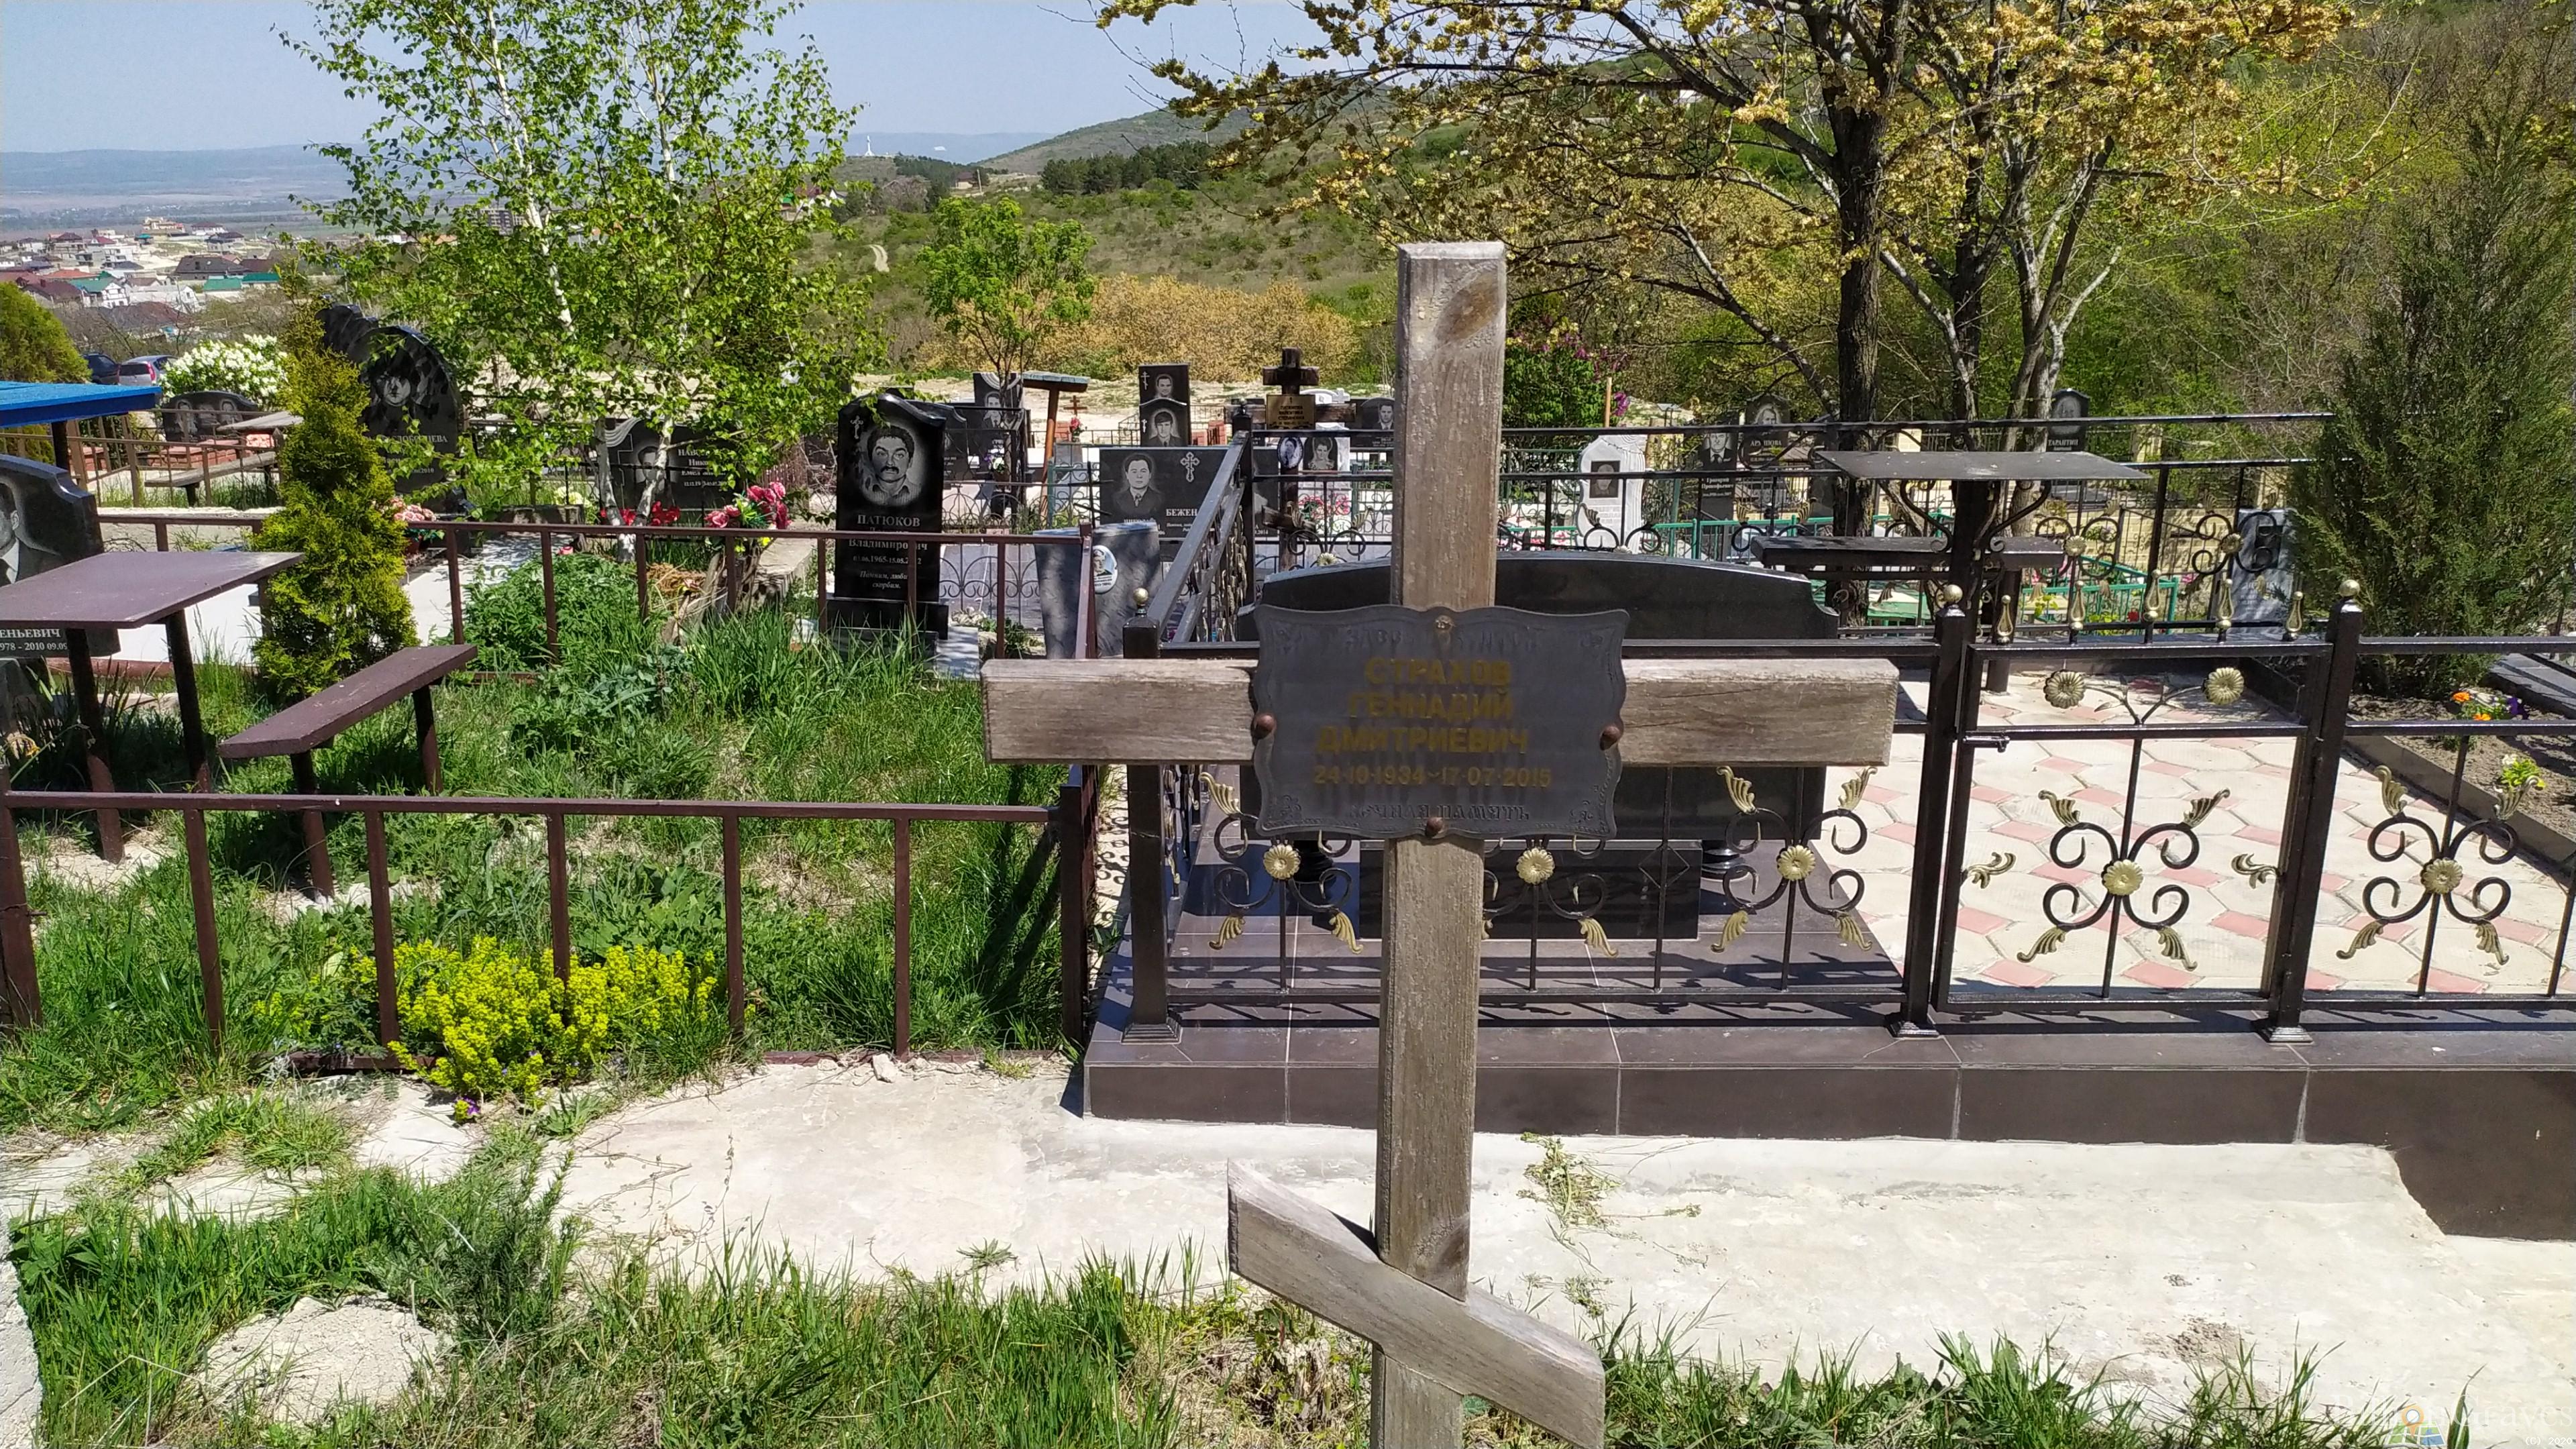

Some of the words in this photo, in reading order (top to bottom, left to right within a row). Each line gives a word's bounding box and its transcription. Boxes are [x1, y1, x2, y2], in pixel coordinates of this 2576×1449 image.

[1165, 508, 1198, 517] БЕЖЕН
[857, 515, 921, 527] ПАТЮКОВ
[849, 539, 928, 551] Владимироич
[24, 642, 46, 651] 2010
[1364, 657, 1512, 686] СТРАХОВ
[1349, 688, 1513, 722] ГЕННАДИЙ
[1315, 726, 1529, 755] ДМИТРИЕВИЧ
[1436, 804, 1530, 821] ПАМЯТЬ
